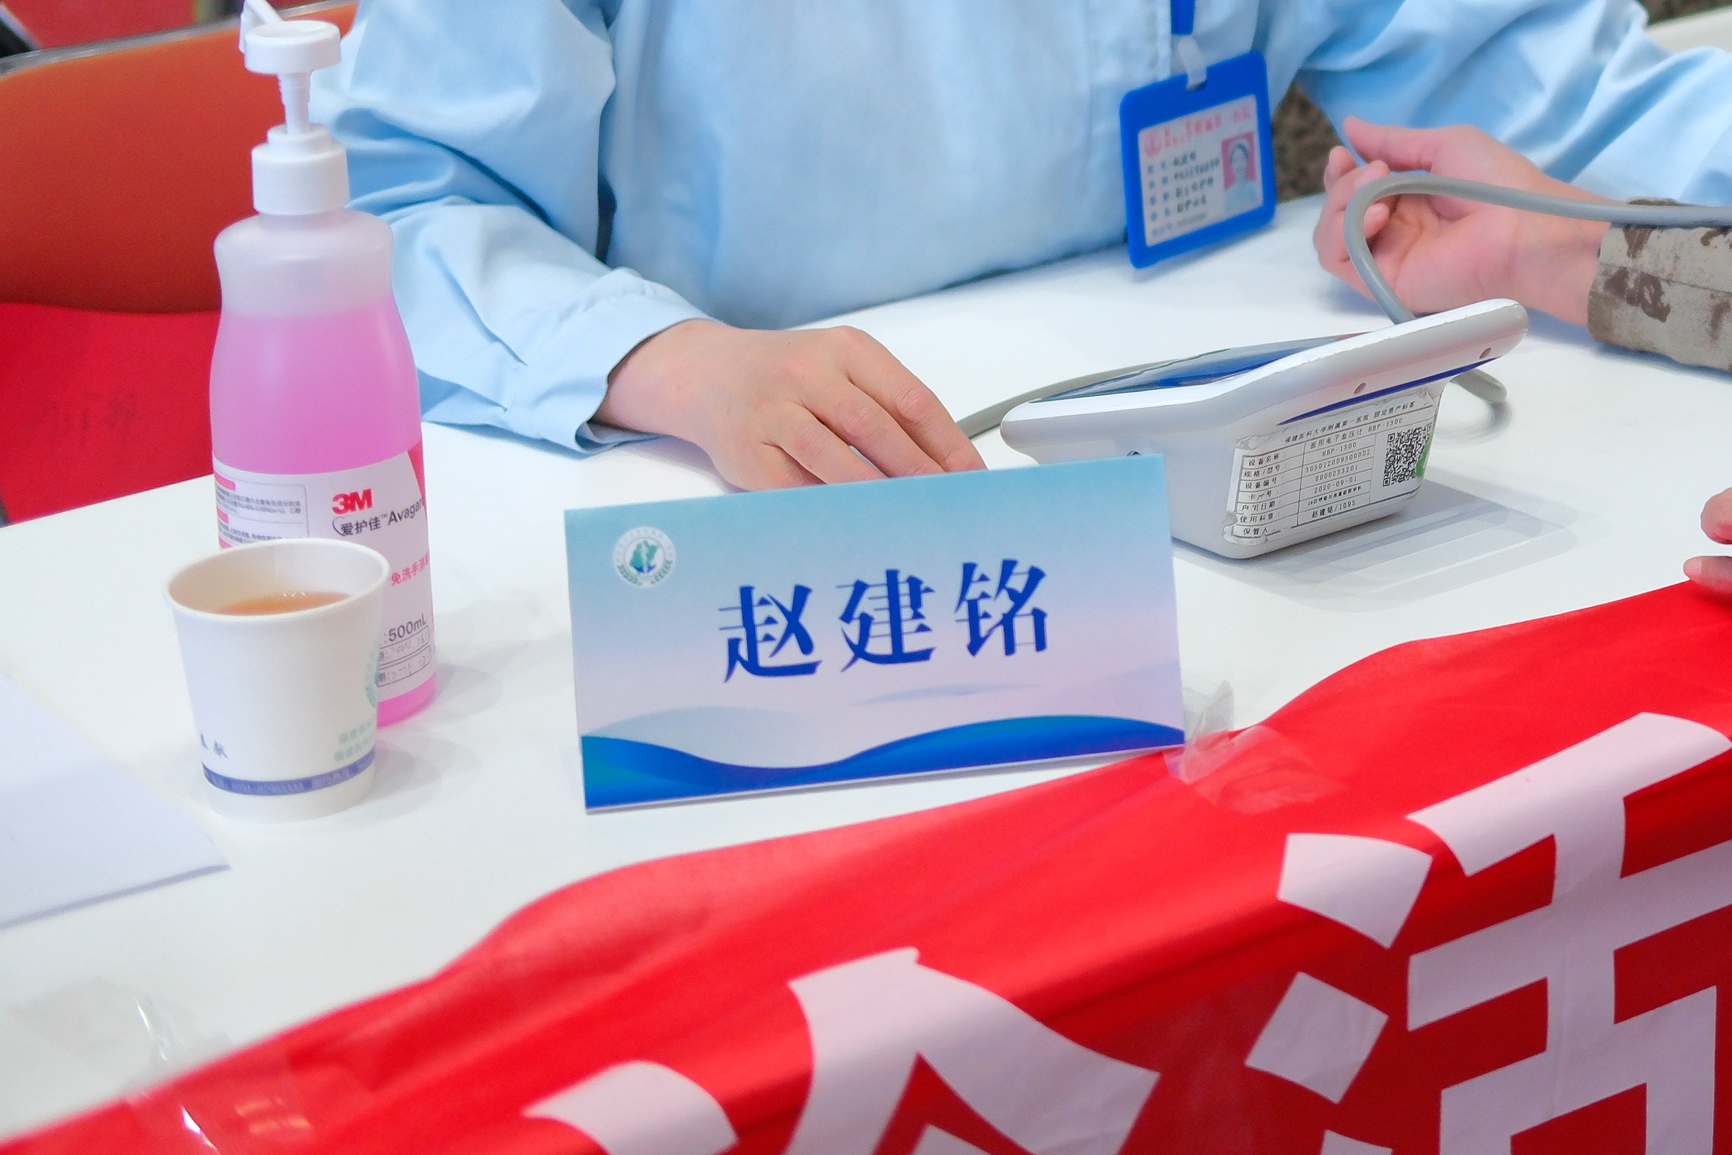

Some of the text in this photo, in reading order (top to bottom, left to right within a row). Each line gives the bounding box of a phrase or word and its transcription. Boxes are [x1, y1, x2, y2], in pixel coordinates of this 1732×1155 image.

[1321, 441, 1357, 457] HBP-1300
[1314, 476, 1358, 494] 2020-09-01
[332, 488, 373, 515] 3M
[388, 498, 423, 526] Avagar
[719, 558, 1048, 684] 赵建铭
